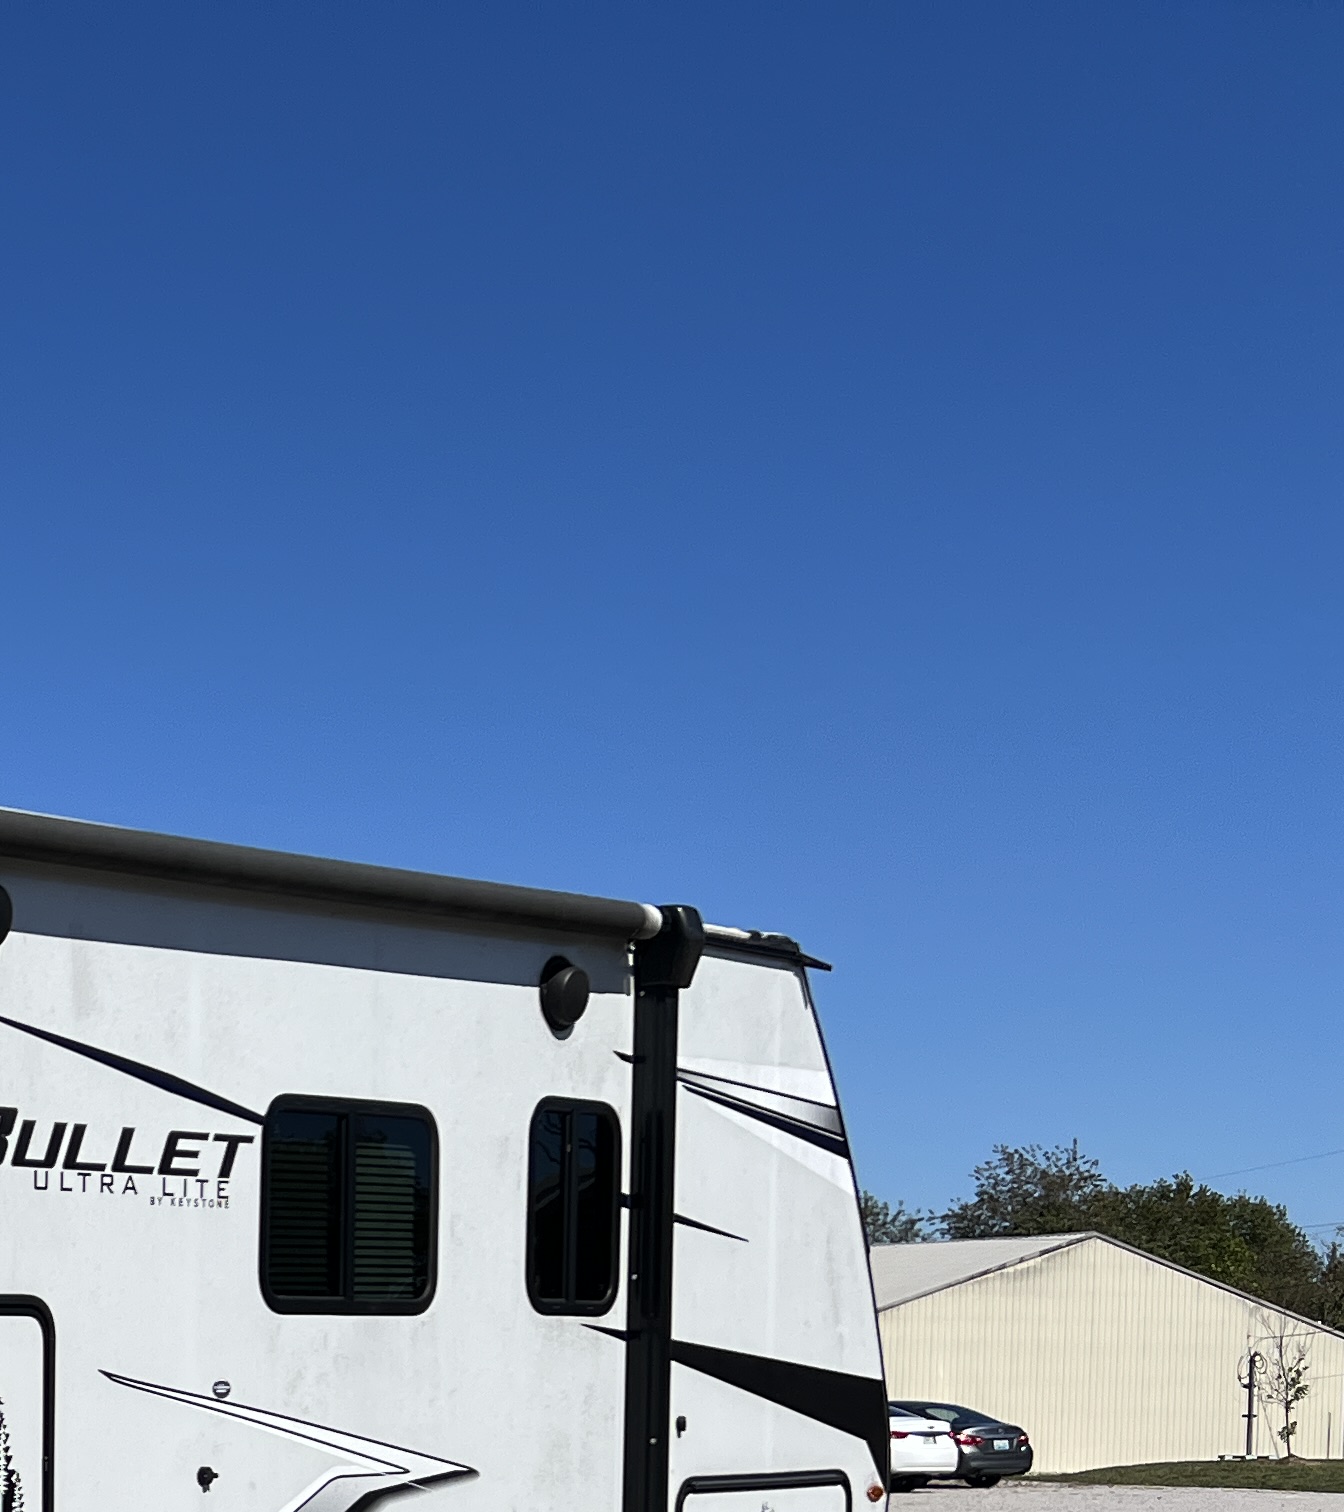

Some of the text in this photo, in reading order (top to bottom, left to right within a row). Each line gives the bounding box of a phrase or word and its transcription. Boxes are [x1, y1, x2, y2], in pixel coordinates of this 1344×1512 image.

[33, 1170, 230, 1199] ULTRA LITE
[150, 1196, 230, 1209] BY KEYSTONE
